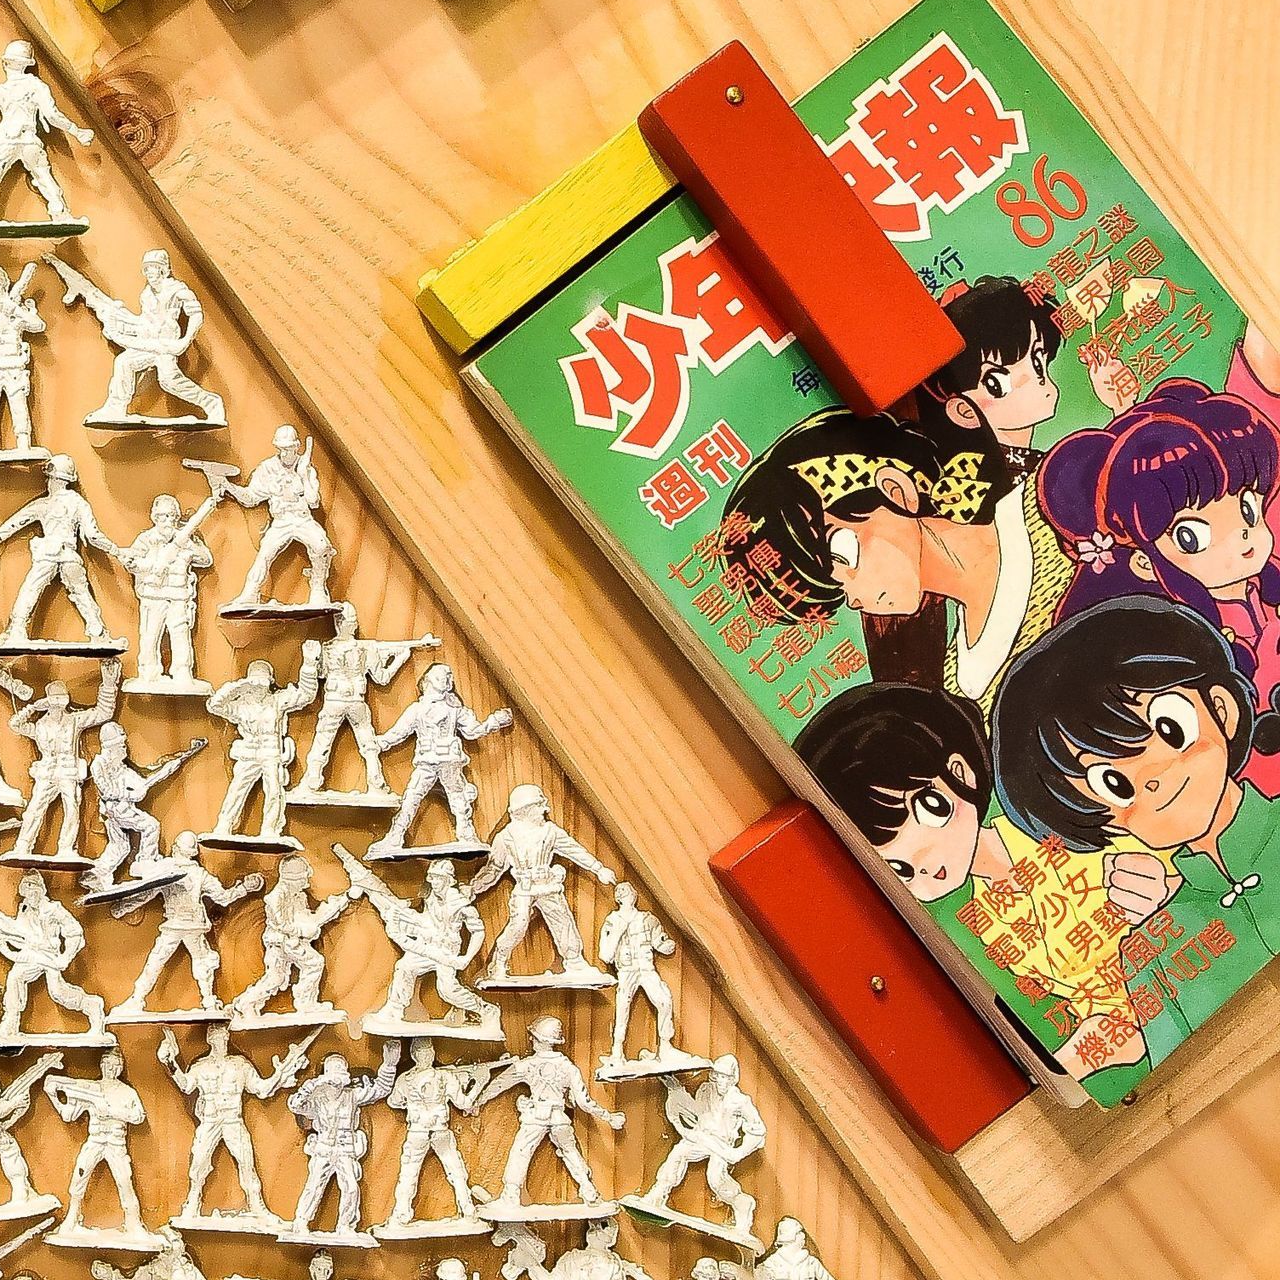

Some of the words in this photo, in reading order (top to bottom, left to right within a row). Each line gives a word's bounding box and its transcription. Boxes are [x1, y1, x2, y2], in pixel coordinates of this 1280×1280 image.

[995, 154, 1087, 247] 86
[1021, 203, 1138, 306] 神龍之謎
[1050, 236, 1165, 339] 魔界學園
[1078, 277, 1196, 373] 城市獵人
[639, 420, 752, 529] 週刊
[668, 511, 751, 588] 七笑拳
[718, 570, 810, 653] 破壞王
[749, 605, 838, 683] 七龍珠
[778, 638, 868, 719] 七小福
[956, 834, 1071, 937] 冒險勇者
[985, 867, 1103, 970] 電影少女
[1043, 909, 1185, 1037] 功夫旋風兒
